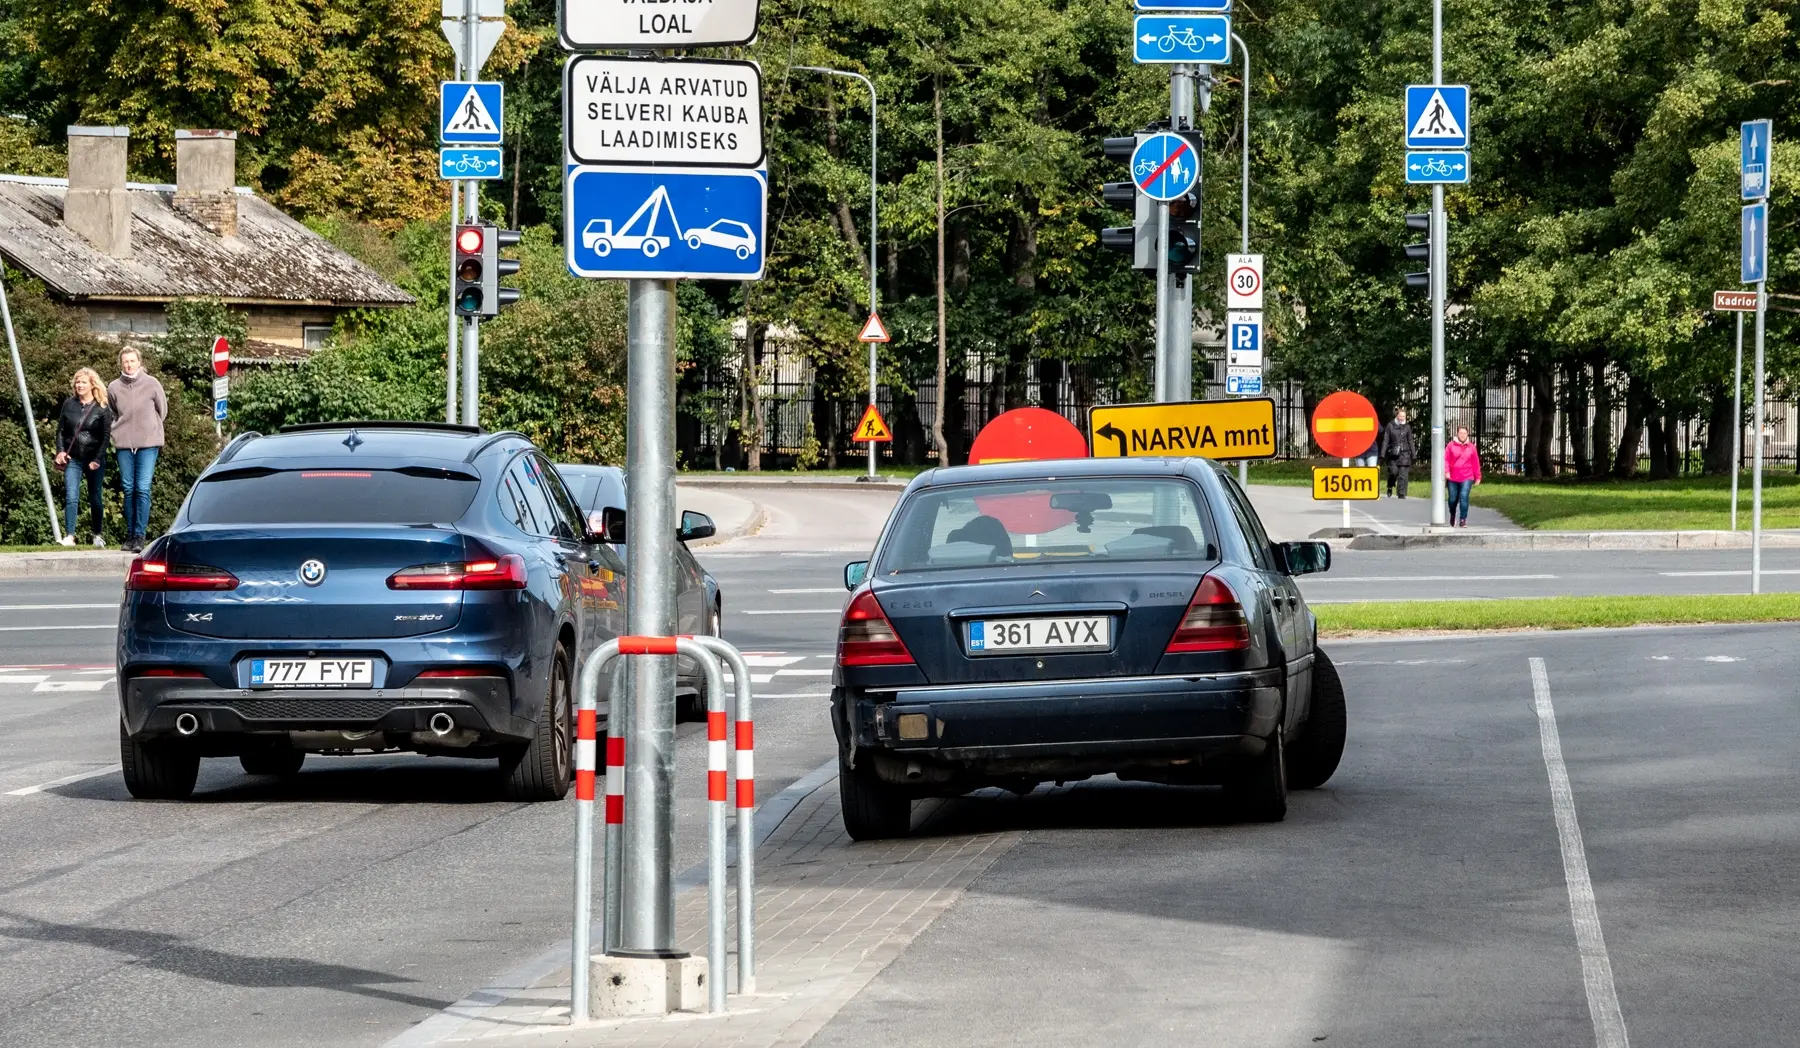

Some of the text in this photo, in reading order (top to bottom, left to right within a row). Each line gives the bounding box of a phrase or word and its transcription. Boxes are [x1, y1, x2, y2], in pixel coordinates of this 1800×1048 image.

[640, 14, 692, 34] LOAL
[586, 72, 748, 98] VÄLJA ARVATUD
[587, 102, 748, 124] SELVERI KAUBA
[600, 130, 738, 150] LAADIMISEKS
[1238, 275, 1254, 288] 30
[1718, 296, 1756, 306] Kadrior
[1132, 424, 1270, 452] NARVA mnt
[1321, 474, 1372, 492] 150m
[183, 613, 214, 622] X4
[992, 620, 1098, 646] 361 AYX
[269, 662, 366, 681] 777 FYF
